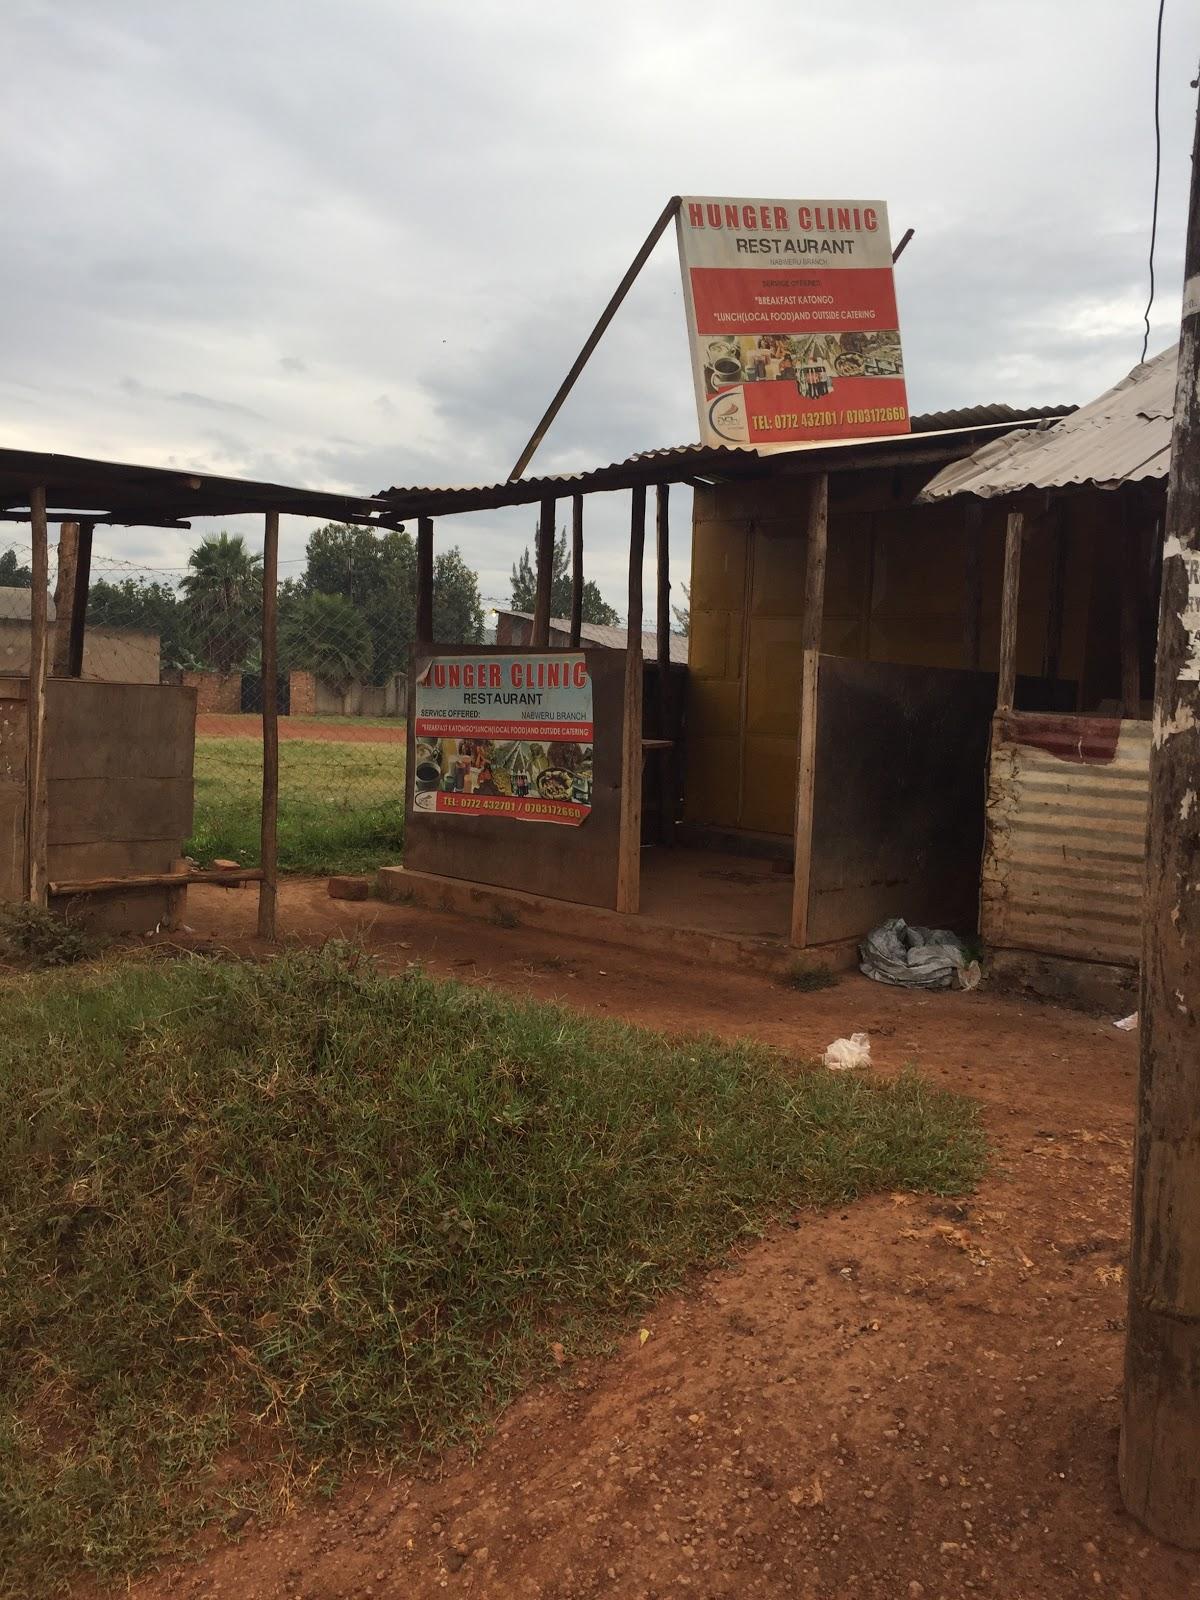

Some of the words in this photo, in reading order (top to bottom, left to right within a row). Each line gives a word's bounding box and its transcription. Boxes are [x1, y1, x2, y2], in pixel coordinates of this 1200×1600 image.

[688, 203, 789, 231] HUNGER
[798, 206, 879, 232] CLINIC
[736, 238, 855, 254] RESTAURANT
[797, 295, 834, 305] KATONGO
[812, 311, 840, 320] OUTSIDE
[841, 310, 876, 319] CATERING
[752, 415, 773, 430] TEL:
[774, 414, 799, 429] 0772
[801, 411, 837, 427] 432701
[846, 406, 906, 424] 0703172660
[510, 661, 588, 689] CLINIC
[463, 693, 543, 705] RESTAURANT
[420, 709, 447, 717] SERVICE
[447, 709, 481, 718] OFFERED:
[521, 711, 555, 720] NABWERU
[556, 712, 587, 720] BRANCH
[540, 727, 561, 735] OUTSIDE
[561, 728, 589, 737] CATERING
[461, 798, 480, 809] 0772
[482, 800, 515, 812] 432701
